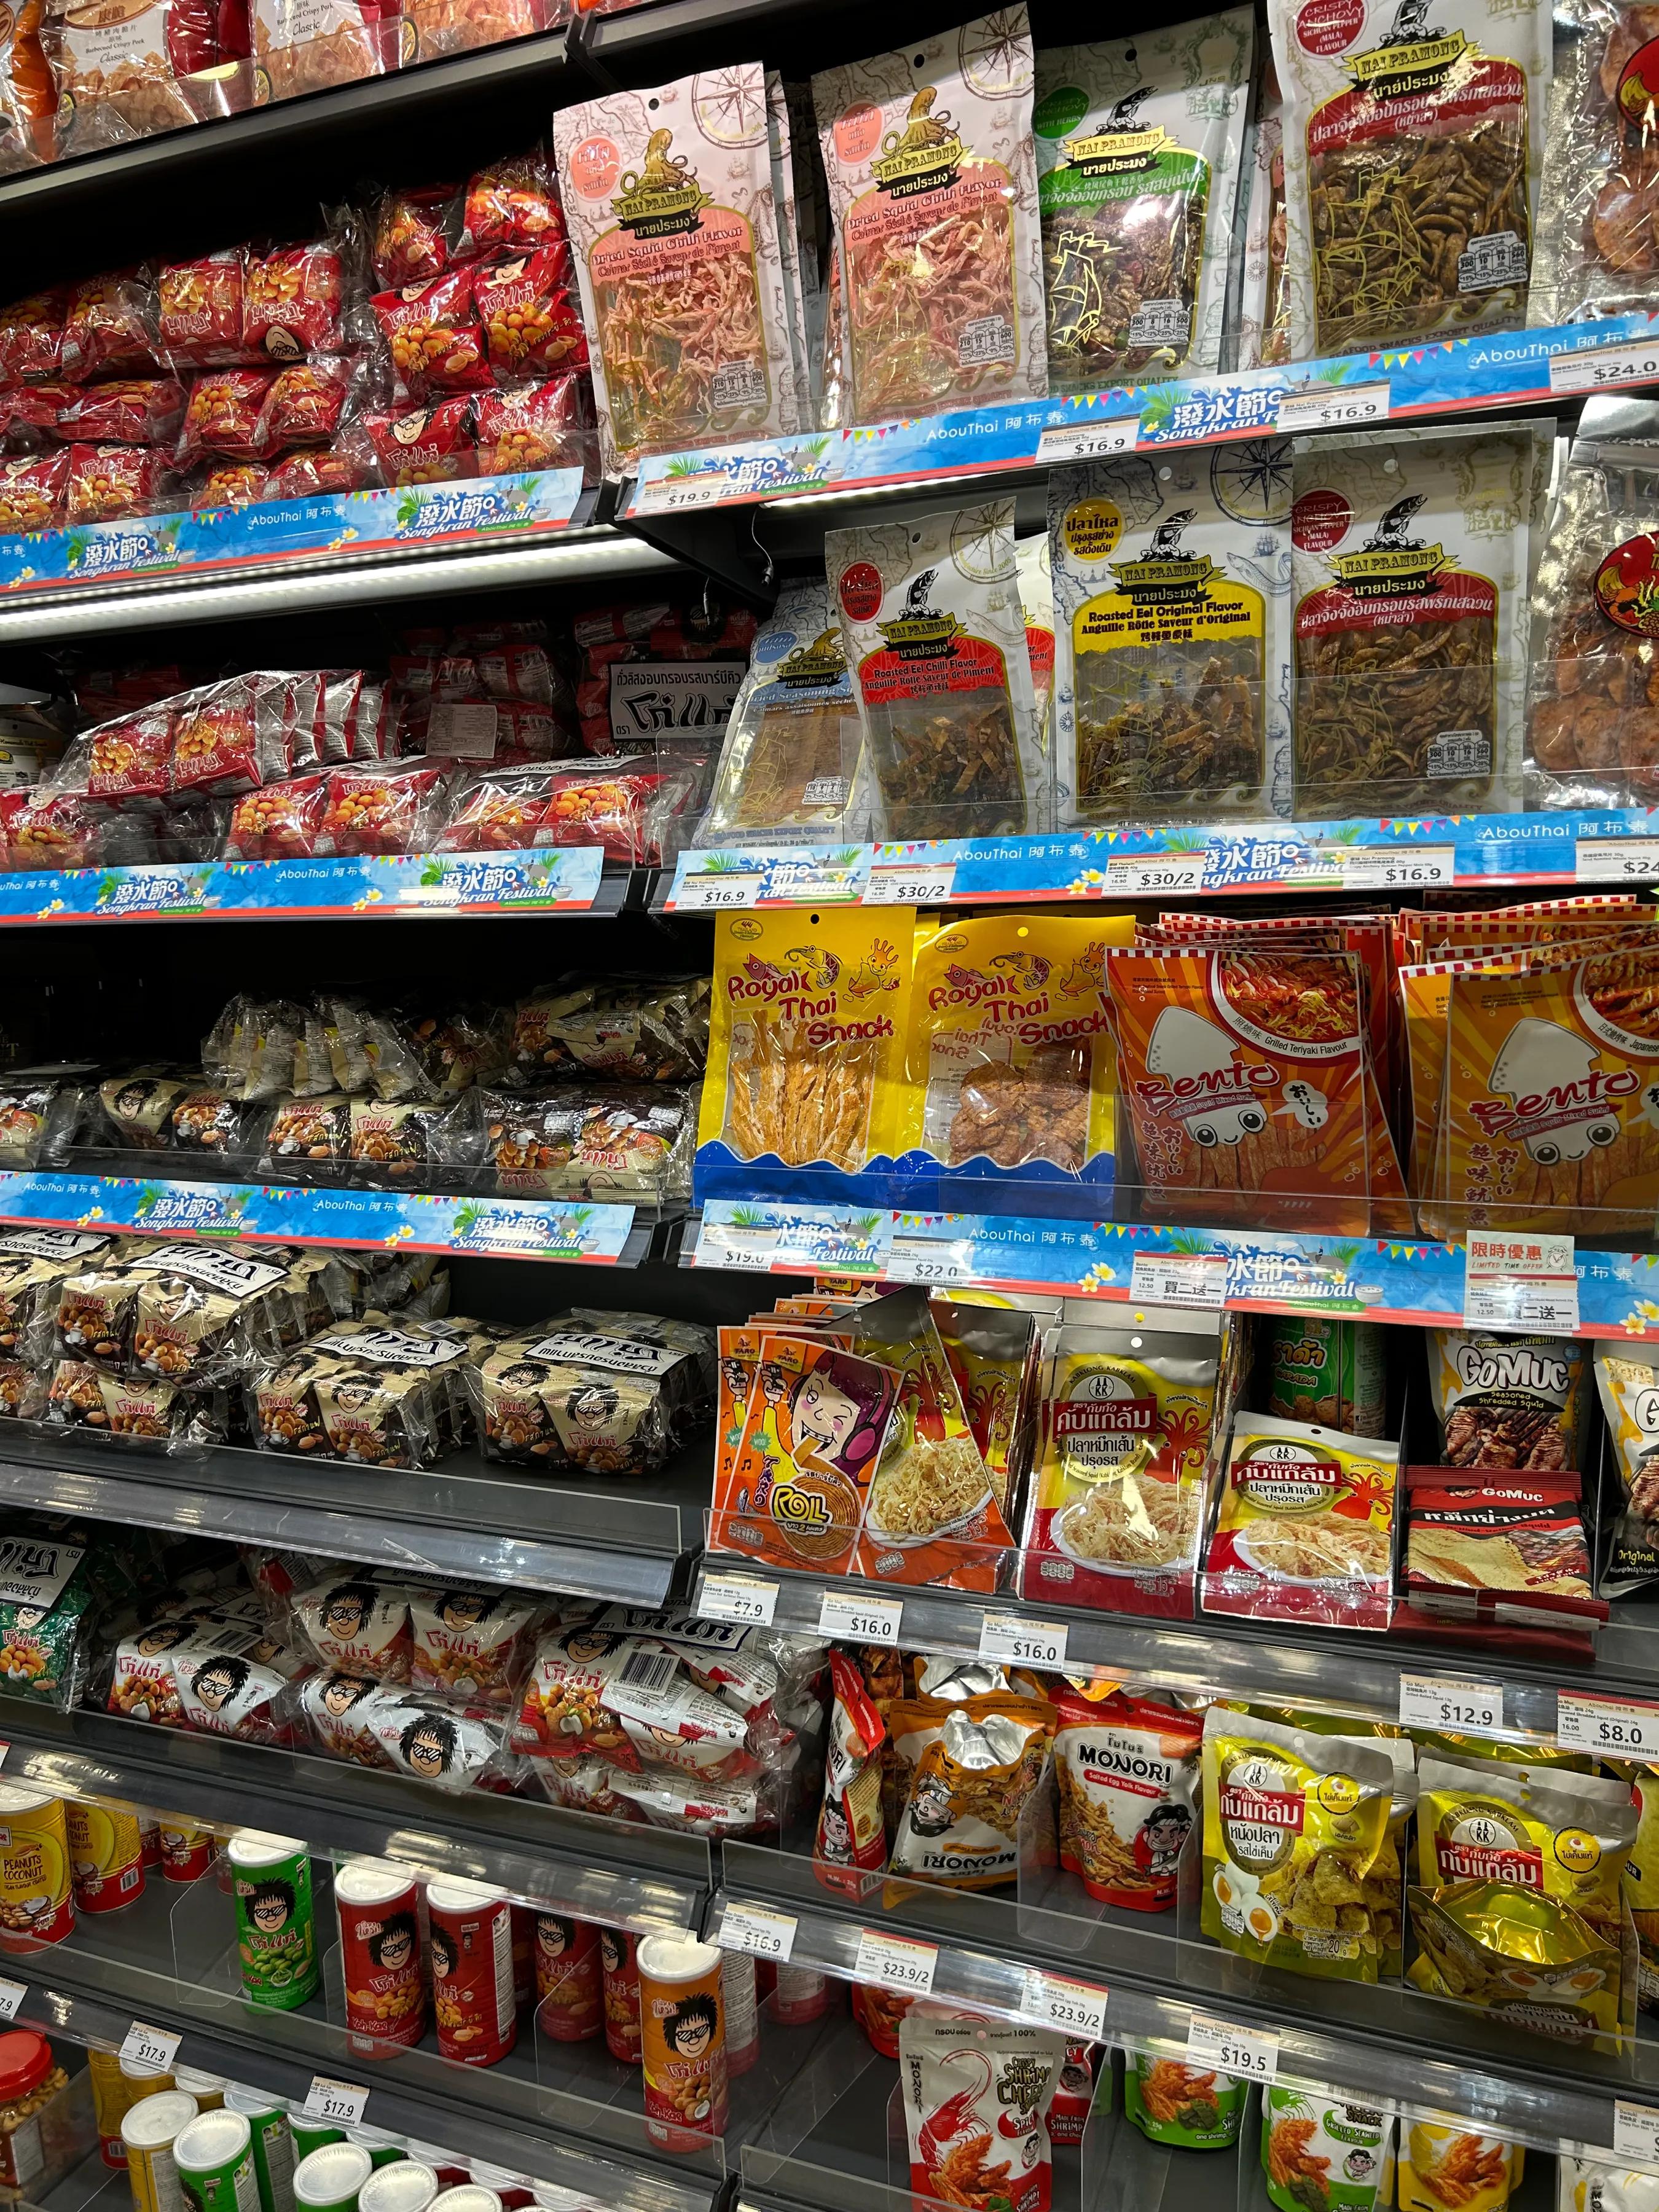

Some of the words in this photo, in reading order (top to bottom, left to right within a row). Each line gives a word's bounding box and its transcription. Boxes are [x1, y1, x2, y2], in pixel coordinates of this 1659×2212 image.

[1316, 39, 1347, 53] FLAVOUR
[1319, 31, 1343, 44] (MALA)
[1361, 58, 1387, 74] NAI
[1389, 39, 1460, 65] PRAMONG
[1077, 142, 1099, 155] NAI
[1100, 133, 1160, 151] PRAMONG
[884, 162, 902, 177] NAI
[904, 145, 957, 171] PRAMONG
[1083, 157, 1147, 176] นายประมง
[892, 172, 948, 197] นายประมง
[625, 199, 643, 216] NAI
[644, 189, 697, 211] PRAMONG
[847, 213, 880, 230] Dried
[882, 202, 918, 219] Squid
[922, 190, 956, 206] Chilli
[960, 179, 1002, 195] Flavor
[852, 225, 884, 241] Calmar
[914, 208, 946, 223] Saveur
[947, 202, 959, 211] de
[961, 192, 998, 208] Piment
[635, 217, 691, 238] นายประมง
[591, 249, 625, 266] Dried
[628, 243, 664, 260] Squid
[666, 232, 700, 250] Chilli
[702, 226, 743, 244] Flavor
[1476, 342, 1568, 364] AbouThai
[1594, 360, 1657, 380] $24.0
[1320, 404, 1377, 423] $16.9
[924, 419, 998, 442] AbouThai
[1154, 417, 1260, 444] Songkran
[1073, 437, 1125, 456] $16.9
[756, 468, 822, 491] Festival
[667, 491, 710, 506] $19.9
[251, 512, 301, 527] AbouThai
[399, 521, 473, 539] Songkran
[474, 508, 531, 528] Festival
[1304, 540, 1333, 549] FLAVOUR
[69, 560, 130, 578] Songkran
[132, 550, 179, 568] Festival
[1125, 567, 1144, 581] NAI
[1148, 563, 1207, 579] PRAMONG
[1344, 559, 1368, 573] NAI
[1371, 552, 1438, 571] PRAMONG
[1134, 588, 1196, 602] นายประมง
[1355, 578, 1426, 596] นายประมง
[1089, 609, 1133, 622] Roasted
[1136, 608, 1153, 618] Eel
[1156, 606, 1202, 619] Original
[1206, 602, 1243, 613] Flavor
[890, 627, 906, 638] NAI
[908, 621, 953, 635] PRAMONG
[1081, 622, 1124, 635] Anguille
[1158, 618, 1193, 628] Saveur
[1196, 611, 1250, 625] d'Original
[900, 644, 947, 657] นายประมง
[874, 667, 908, 678] Roasted
[911, 664, 924, 673] Eel
[925, 662, 947, 672] Chilli
[950, 659, 977, 669] Flavor
[616, 725, 630, 735] ตรา
[1482, 824, 1569, 839] AbouThai
[954, 847, 1021, 861] AbouThai
[280, 868, 329, 879] AbouThai
[1140, 873, 1194, 887] $30/2
[1386, 867, 1441, 882] $16.9
[497, 885, 554, 900] Festival
[704, 892, 745, 903] $16.9
[897, 885, 945, 898] $30/2
[96, 900, 157, 915] Songkran
[159, 895, 205, 909] Festival
[728, 969, 800, 1003] Royal
[928, 975, 1006, 1012] Royal
[778, 990, 836, 1021] Thai
[984, 992, 1049, 1023] Thai
[806, 1016, 894, 1046] Snack
[1018, 1010, 1109, 1045] Snack
[1265, 1035, 1289, 1051] Grilled
[1290, 1043, 1319, 1056] Teriyaki
[1319, 1041, 1348, 1055] Flavour
[1136, 1061, 1281, 1118] Bento
[1467, 1068, 1641, 1139] Bento
[25, 1182, 64, 1193] AbouThai
[316, 1199, 366, 1212] AbouThai
[135, 1216, 194, 1231] Songkran
[195, 1216, 243, 1229] Festival
[970, 1228, 1036, 1243] AbouThai
[812, 1245, 873, 1262] Festival
[1471, 1241, 1542, 1260] 限時優惠
[777, 1355, 799, 1365] TARO
[1478, 1397, 1517, 1406] Shredded
[1520, 1399, 1545, 1410] Squid
[1491, 1390, 1531, 1400] Seasoned
[751, 1437, 767, 1446] WOO!
[1067, 1432, 1134, 1454] ปลาหมึกเส้น
[1081, 1453, 1119, 1468] ปรุงรส
[1277, 1450, 1290, 1459] KK
[1237, 1464, 1336, 1483] กับแกล้ม
[1249, 1481, 1321, 1499] ปลาหมึกเส้น
[1265, 1494, 1305, 1505] ปรุงรส
[772, 1485, 831, 1525] ROLL
[1618, 1548, 1656, 1563] Original
[732, 1599, 763, 1617] $7.9
[850, 1616, 892, 1636] $16.0
[1014, 1640, 1058, 1661] $16.0
[1440, 1703, 1493, 1726] $12.9
[1575, 1711, 1596, 1720] Shredded
[1588, 1703, 1614, 1711] AbouThai
[1562, 1723, 1579, 1732] 16.00
[1598, 1722, 1642, 1744] $8.0
[1078, 1742, 1174, 1784] MONORI
[1088, 1771, 1108, 1783] Salted
[1108, 1775, 1120, 1786] Egg
[1121, 1778, 1134, 1789] Yolk
[1135, 1781, 1158, 1794] Flavour
[1220, 1795, 1299, 1825] กับแกล้ม
[1230, 1824, 1280, 1845] หนังปลา
[2, 1853, 42, 1872] PEANUTS
[3, 1862, 43, 1881] COCONUT
[744, 1930, 782, 1952] $16.9
[1328, 1939, 1340, 1955] 20
[882, 1960, 930, 1983] $23.9/2
[1049, 2002, 1100, 2028] $23.9/2
[138, 2042, 167, 2062] $17.9
[1220, 2047, 1266, 2073] $19.5
[911, 2061, 925, 2114] MONORI
[323, 2098, 356, 2118] $17.9
[1618, 2109, 1637, 2117] Daisuki
[1326, 2117, 1354, 2137] GRILLED
[1354, 2127, 1380, 2139] SEAWEED
[1346, 2111, 1382, 2127] SNACK
